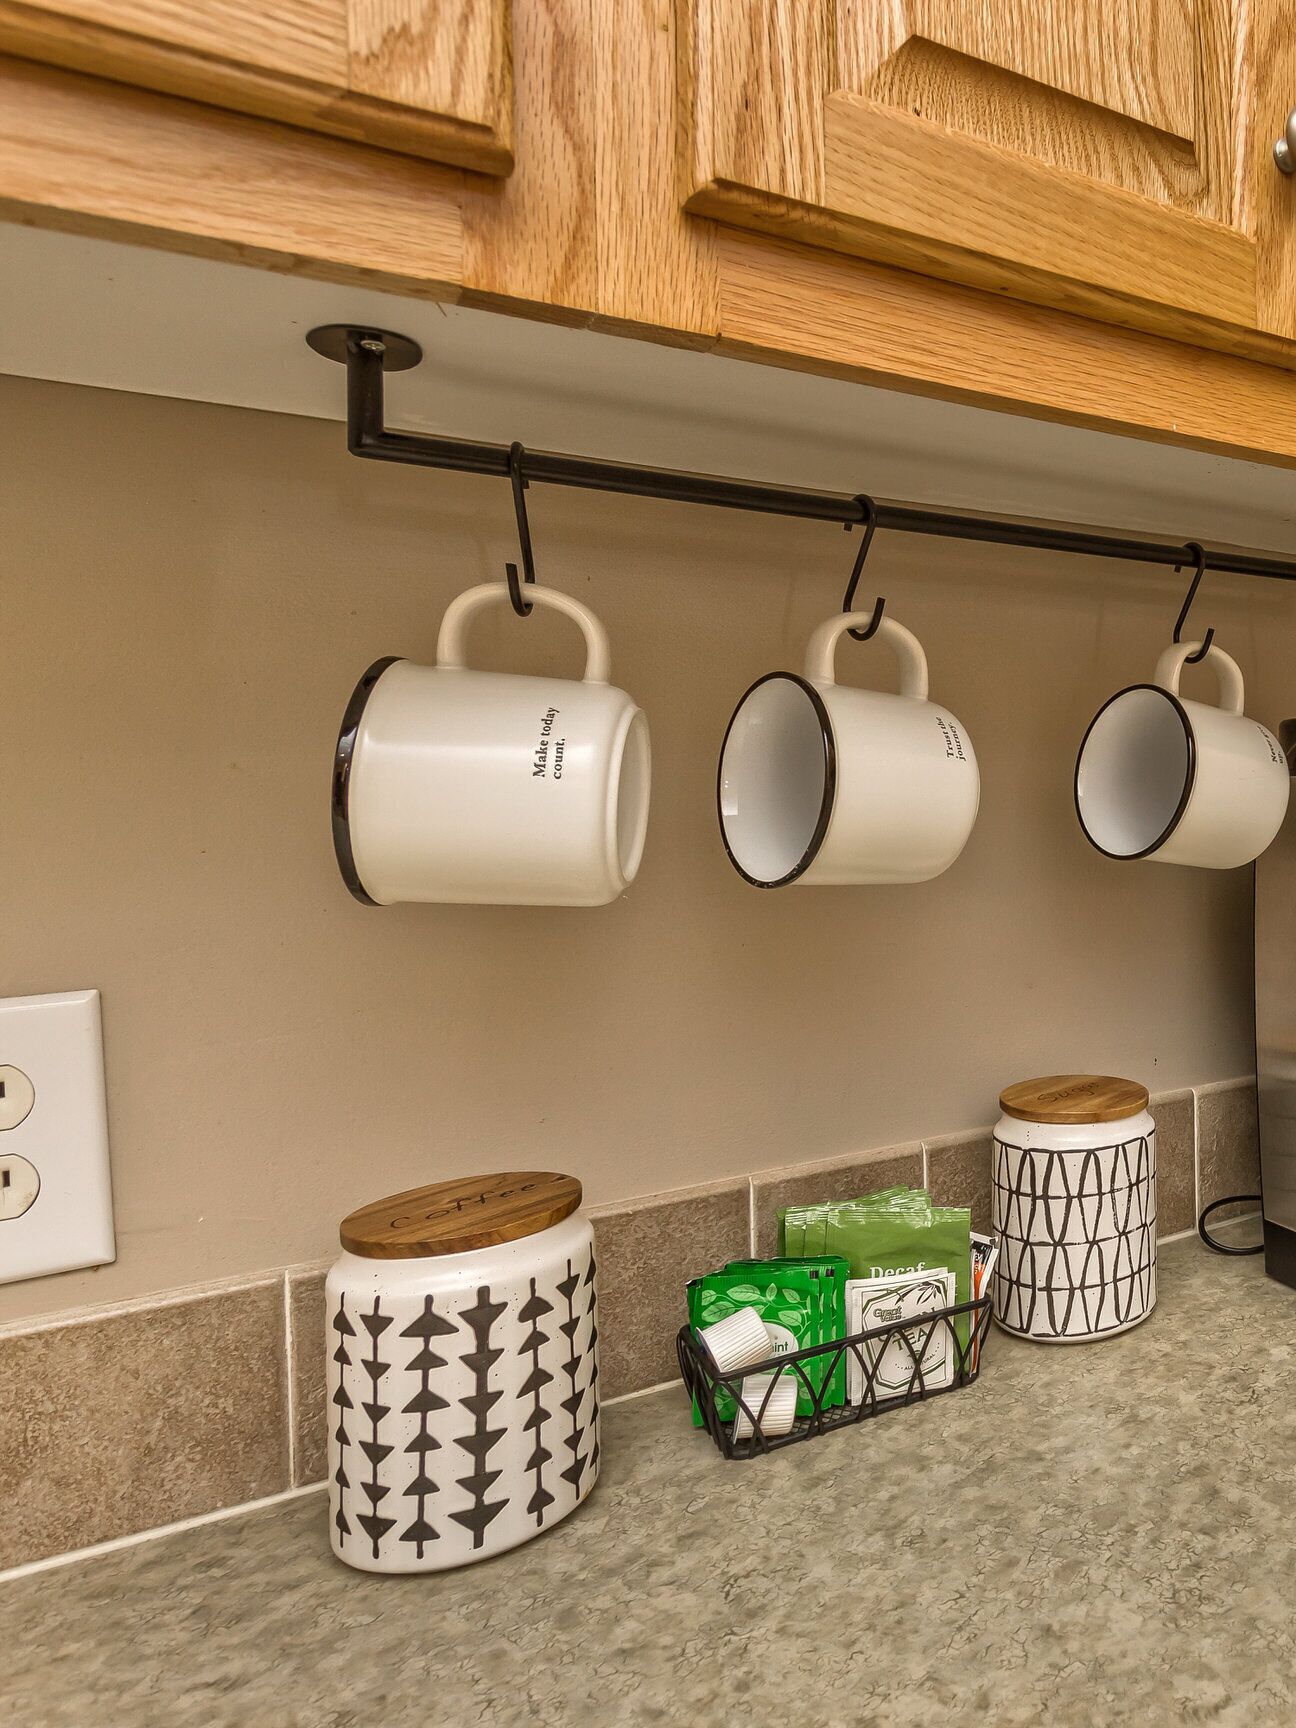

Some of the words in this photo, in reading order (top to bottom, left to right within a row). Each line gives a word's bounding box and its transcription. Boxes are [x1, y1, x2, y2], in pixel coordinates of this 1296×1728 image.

[540, 707, 560, 736] today
[533, 739, 549, 778] Make
[553, 738, 565, 780] count.
[943, 731, 954, 758] Trust
[390, 1182, 537, 1230] Coffee
[873, 1306, 902, 1317] Great
